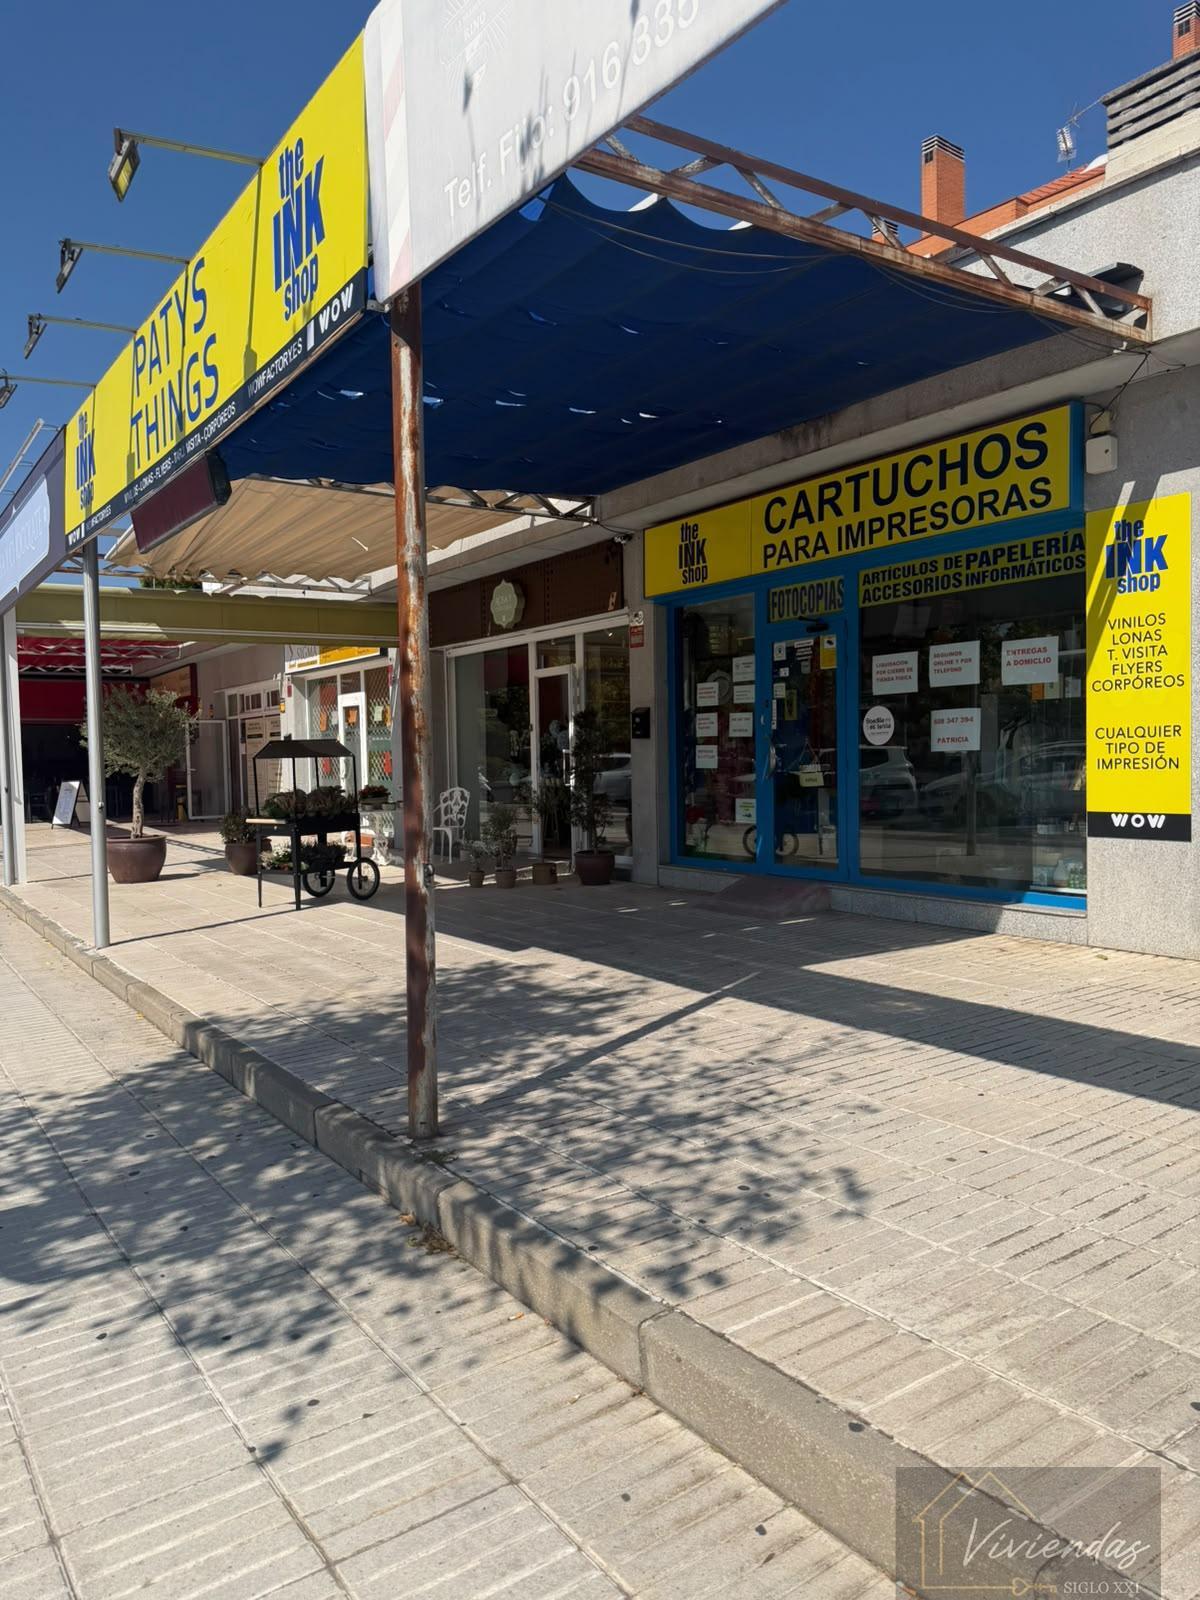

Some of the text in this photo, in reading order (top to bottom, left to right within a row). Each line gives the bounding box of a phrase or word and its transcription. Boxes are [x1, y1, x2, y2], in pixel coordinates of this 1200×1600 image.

[444, 152, 492, 216] Telf.
[563, 41, 621, 121] 916
[278, 137, 304, 200] the
[272, 155, 326, 293] INK
[284, 253, 319, 321] shop
[319, 282, 354, 333] WOW
[133, 256, 208, 398] PATYS
[130, 333, 220, 470] THINGS
[75, 432, 96, 491] INK
[763, 421, 1049, 535] CARTUCHOS
[680, 522, 699, 542] the
[763, 476, 1052, 568] PARA IMPRESORAS
[1114, 519, 1144, 543] the
[678, 538, 707, 569] INK
[862, 531, 1085, 586] ARTÍCULOS DE PAPELERÍA
[1105, 533, 1169, 579] INK
[682, 563, 708, 585] shop
[862, 554, 1086, 604] ACCESORIOS INFORMÁTICOS
[1117, 571, 1161, 594] shop
[771, 577, 845, 619] FOTOCOPIAS
[1108, 613, 1166, 630] VINILOS
[1006, 646, 1048, 656] ENTREGAS
[1112, 629, 1162, 646] LONAS
[1107, 645, 1168, 661] T. VISITA
[1112, 660, 1163, 676] FLYERS
[1092, 674, 1185, 692] CORPÓREOS
[937, 736, 969, 744] PATRICIA
[1095, 724, 1182, 740] CUALQUIER
[1105, 741, 1166, 755] TIPO DE
[1096, 754, 1180, 770] IMPRESIÓN
[1111, 813, 1166, 829] WOW
